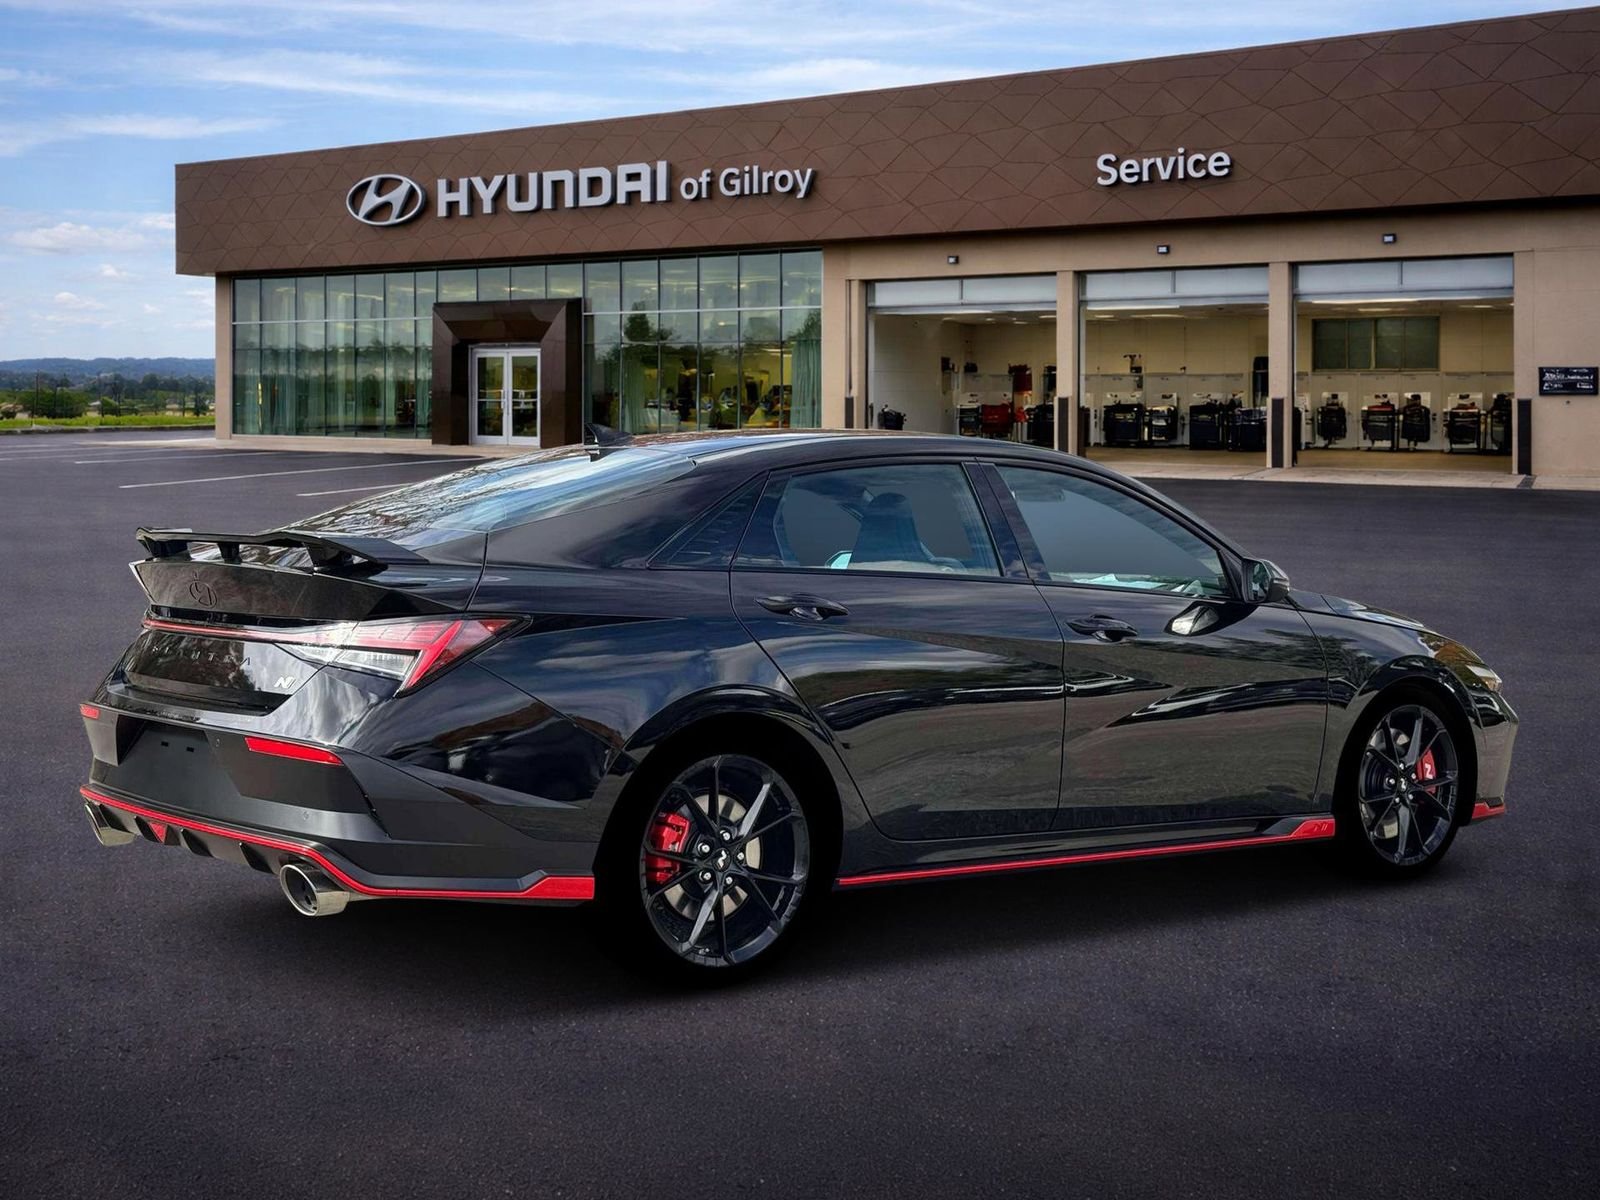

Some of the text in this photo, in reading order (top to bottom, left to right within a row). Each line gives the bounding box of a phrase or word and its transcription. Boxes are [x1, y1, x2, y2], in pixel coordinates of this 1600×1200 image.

[437, 160, 668, 217] HYUNDAI
[680, 168, 712, 200] of
[719, 165, 813, 199] Gilroy
[1096, 147, 1231, 186] Service
